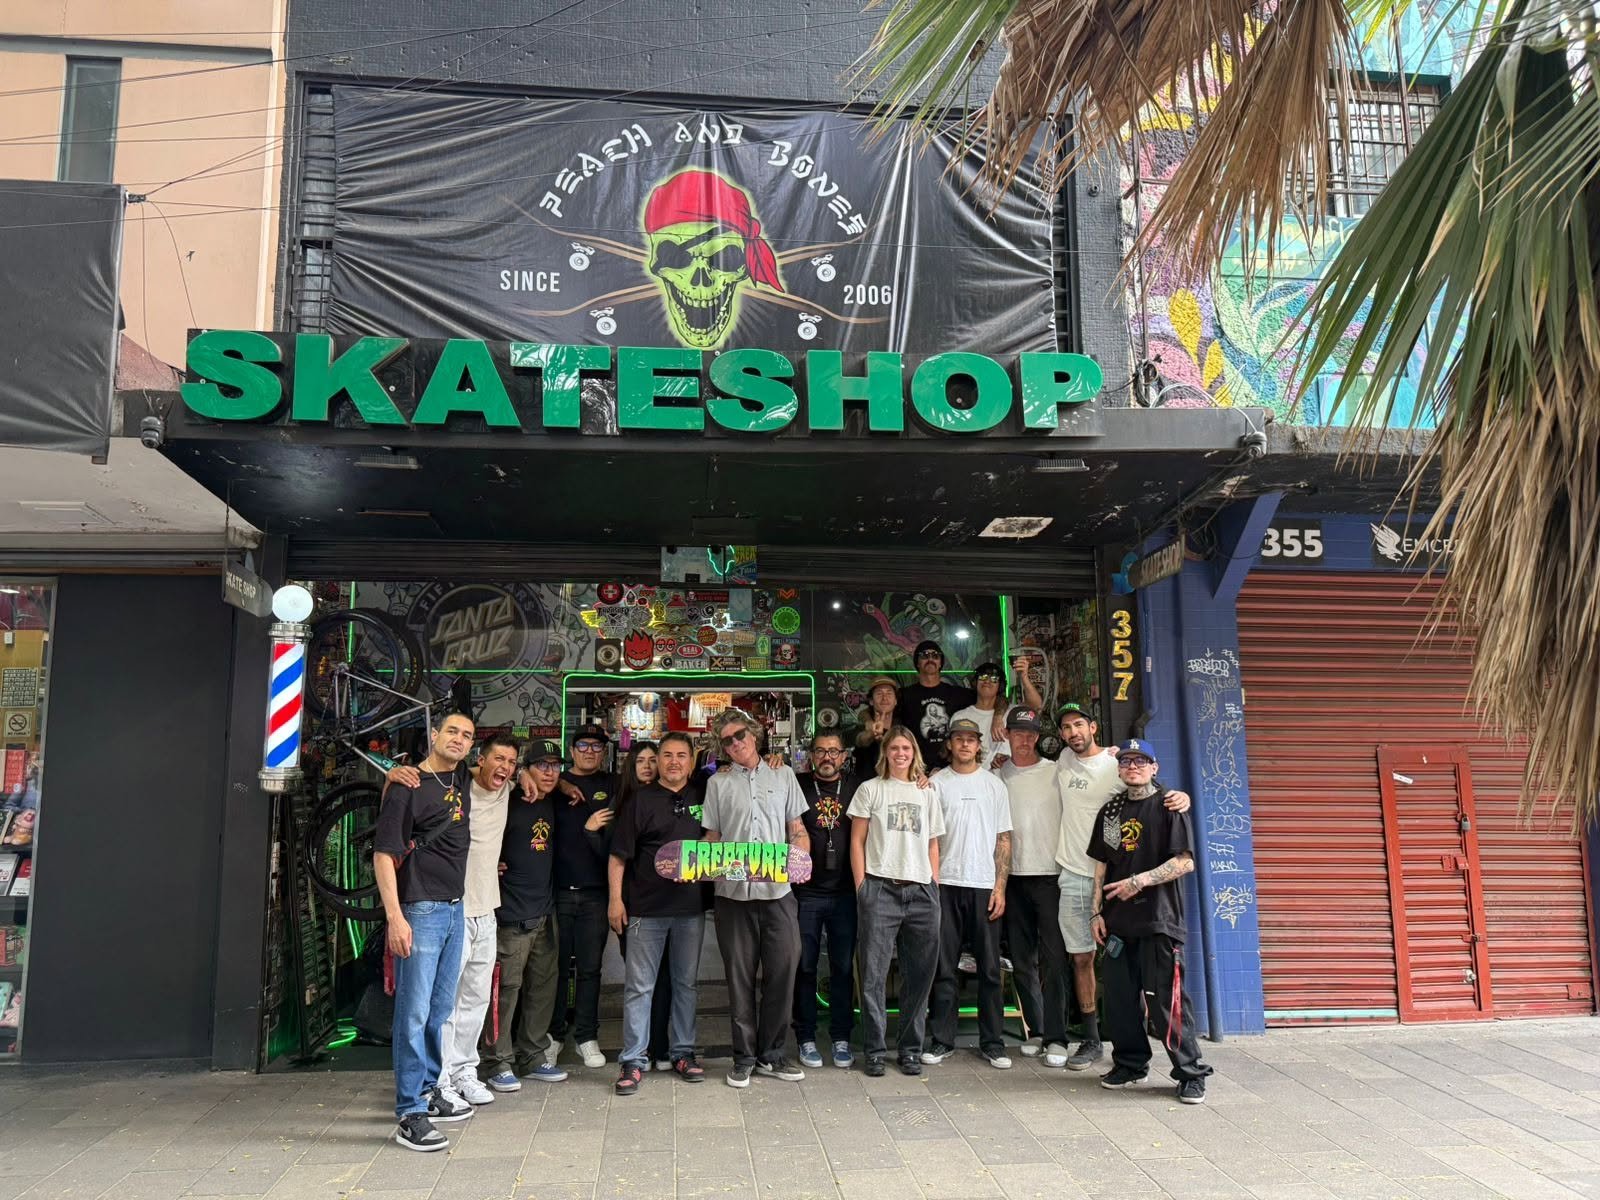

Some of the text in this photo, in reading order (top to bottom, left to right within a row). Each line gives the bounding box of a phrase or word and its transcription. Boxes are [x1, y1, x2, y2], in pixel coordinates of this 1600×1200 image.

[539, 122, 868, 235] PEACH AND BONES
[500, 270, 561, 293] SINCE
[843, 284, 892, 306] 2006
[180, 329, 1104, 433] SKATESHOP
[1261, 528, 1323, 559] 355
[429, 593, 516, 646] SANTA
[442, 625, 516, 669] CRUZ
[1111, 610, 1135, 701] 357
[681, 840, 789, 883] CREATURE
